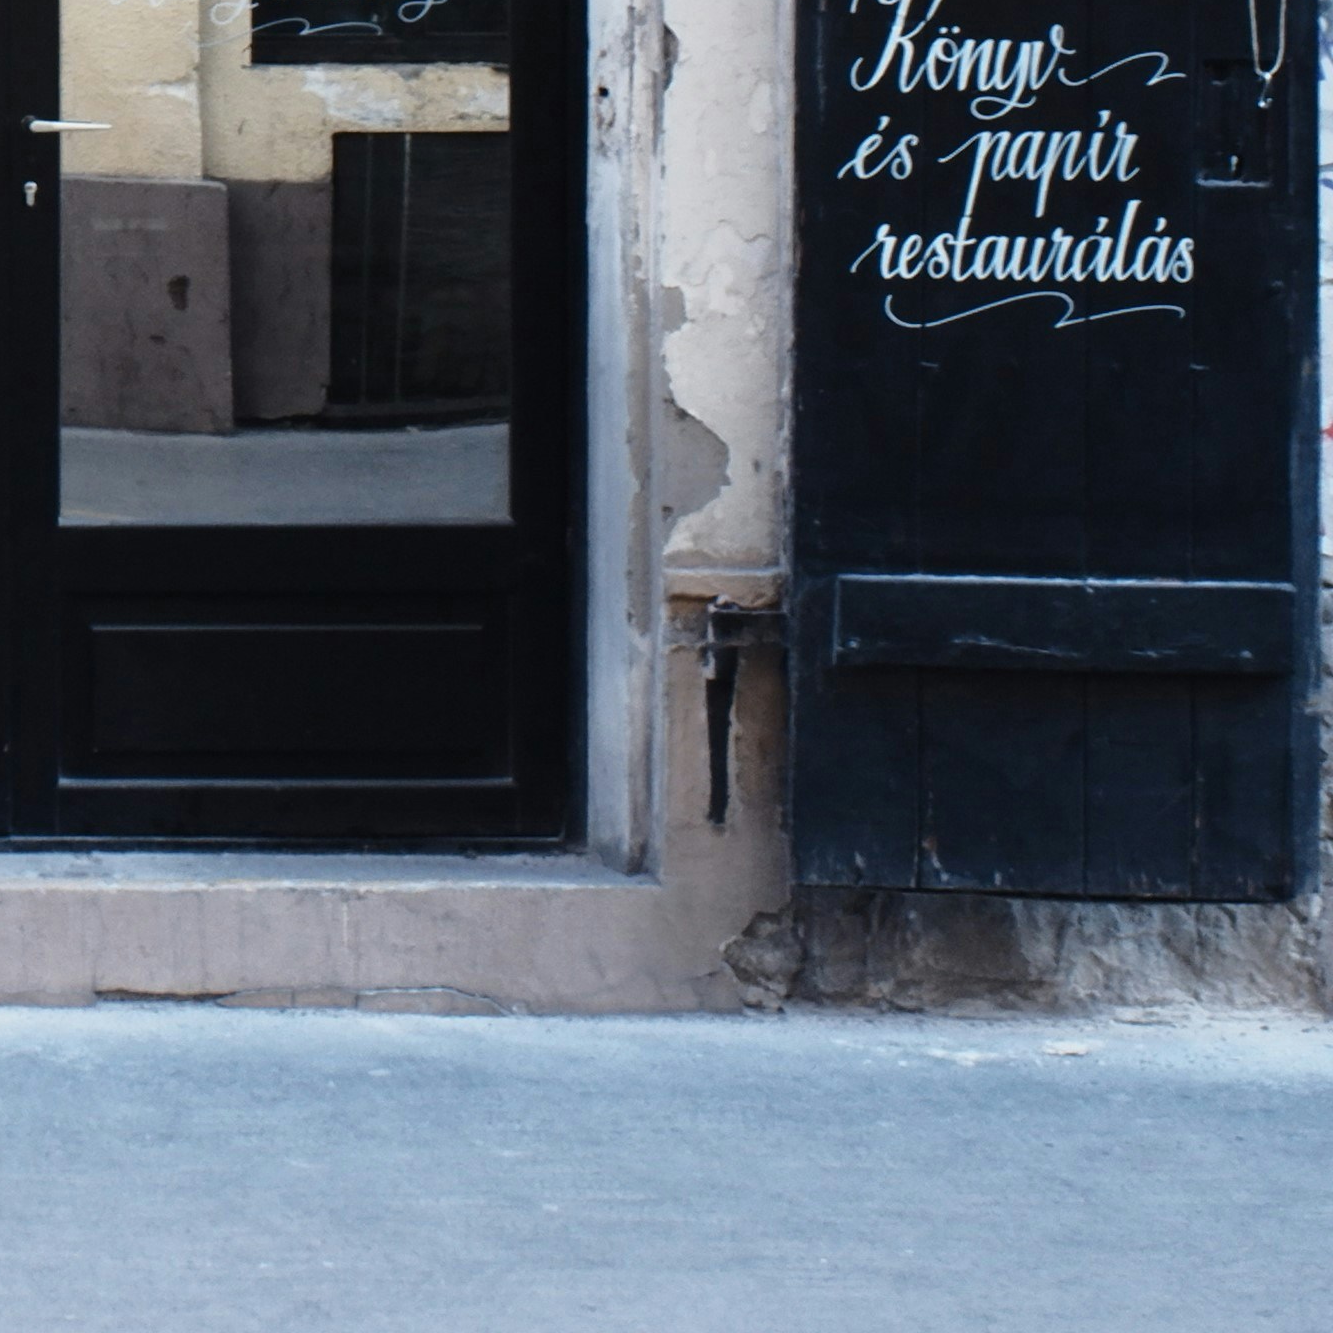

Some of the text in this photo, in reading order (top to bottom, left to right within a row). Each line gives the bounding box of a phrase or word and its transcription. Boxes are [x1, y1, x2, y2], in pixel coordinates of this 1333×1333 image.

[837, 109, 1141, 219] és papír
[849, 199, 1196, 284] restaurálás
